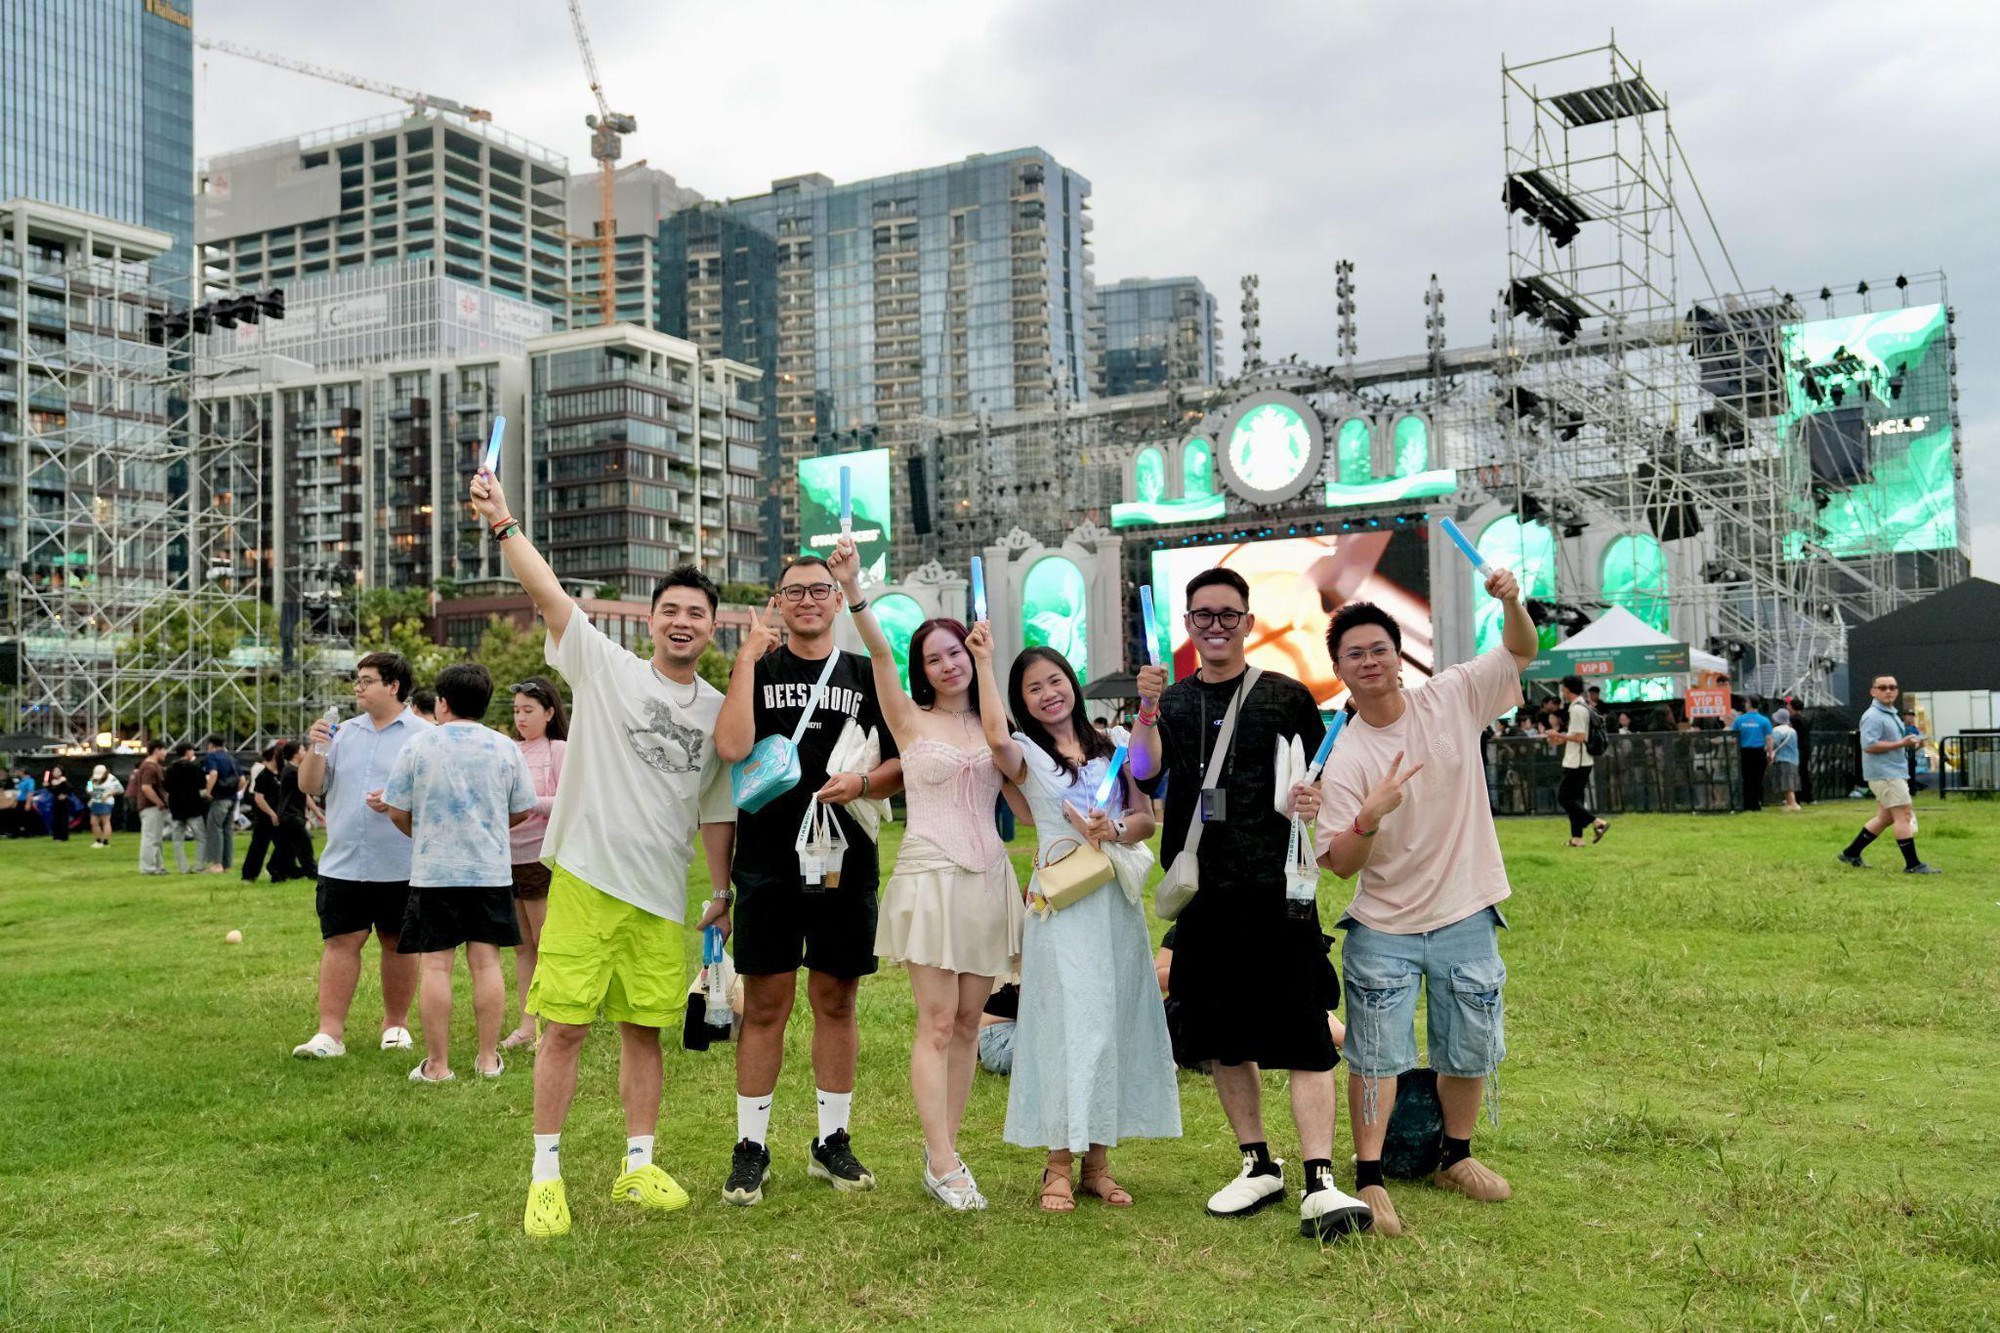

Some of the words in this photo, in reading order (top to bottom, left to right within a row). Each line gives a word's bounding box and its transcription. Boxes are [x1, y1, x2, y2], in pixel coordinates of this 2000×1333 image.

[1581, 663, 1597, 673] VIP
[1599, 662, 1609, 673] B
[1693, 696, 1713, 706] VIP
[1715, 696, 1724, 706] B
